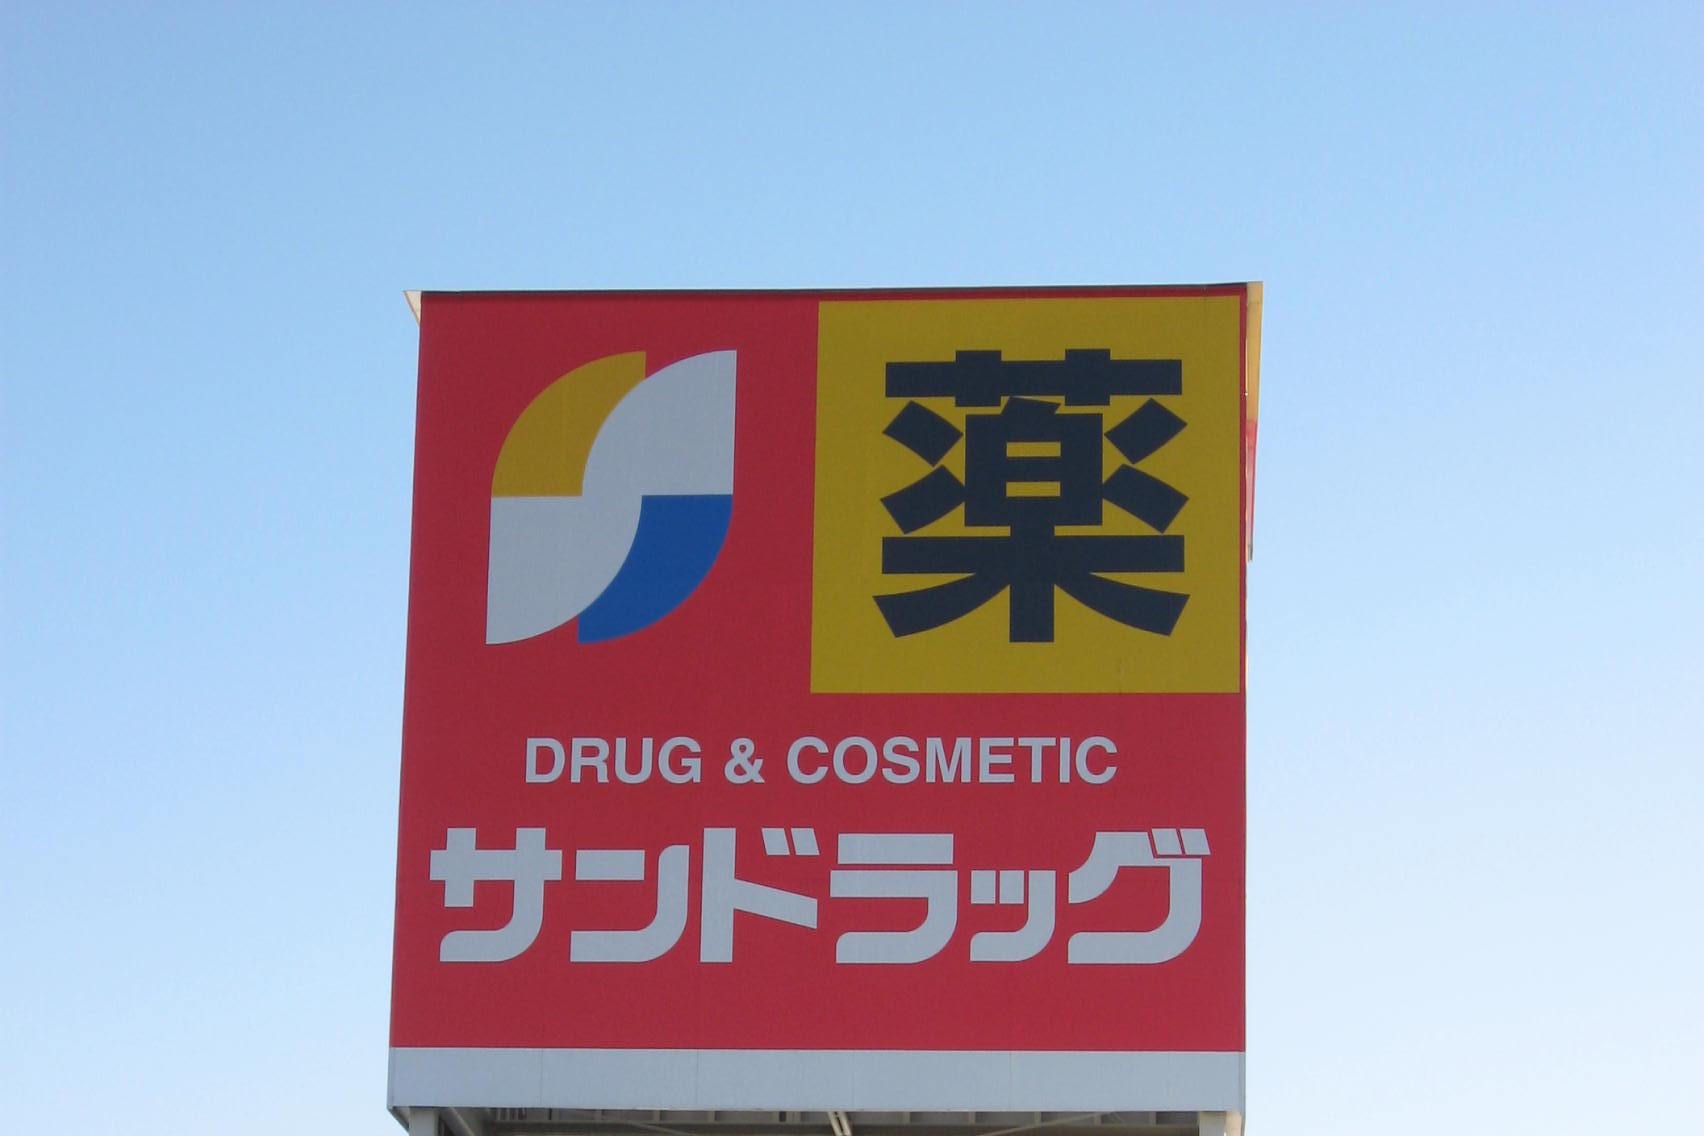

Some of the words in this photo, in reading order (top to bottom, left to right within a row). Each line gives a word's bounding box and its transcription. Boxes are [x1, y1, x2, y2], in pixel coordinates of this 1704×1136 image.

[873, 348, 1190, 643] 薬
[525, 737, 702, 784] DRUG
[724, 737, 765, 785] &
[786, 736, 1119, 785] COSMETIC
[430, 827, 1211, 965] サンドラッグ
